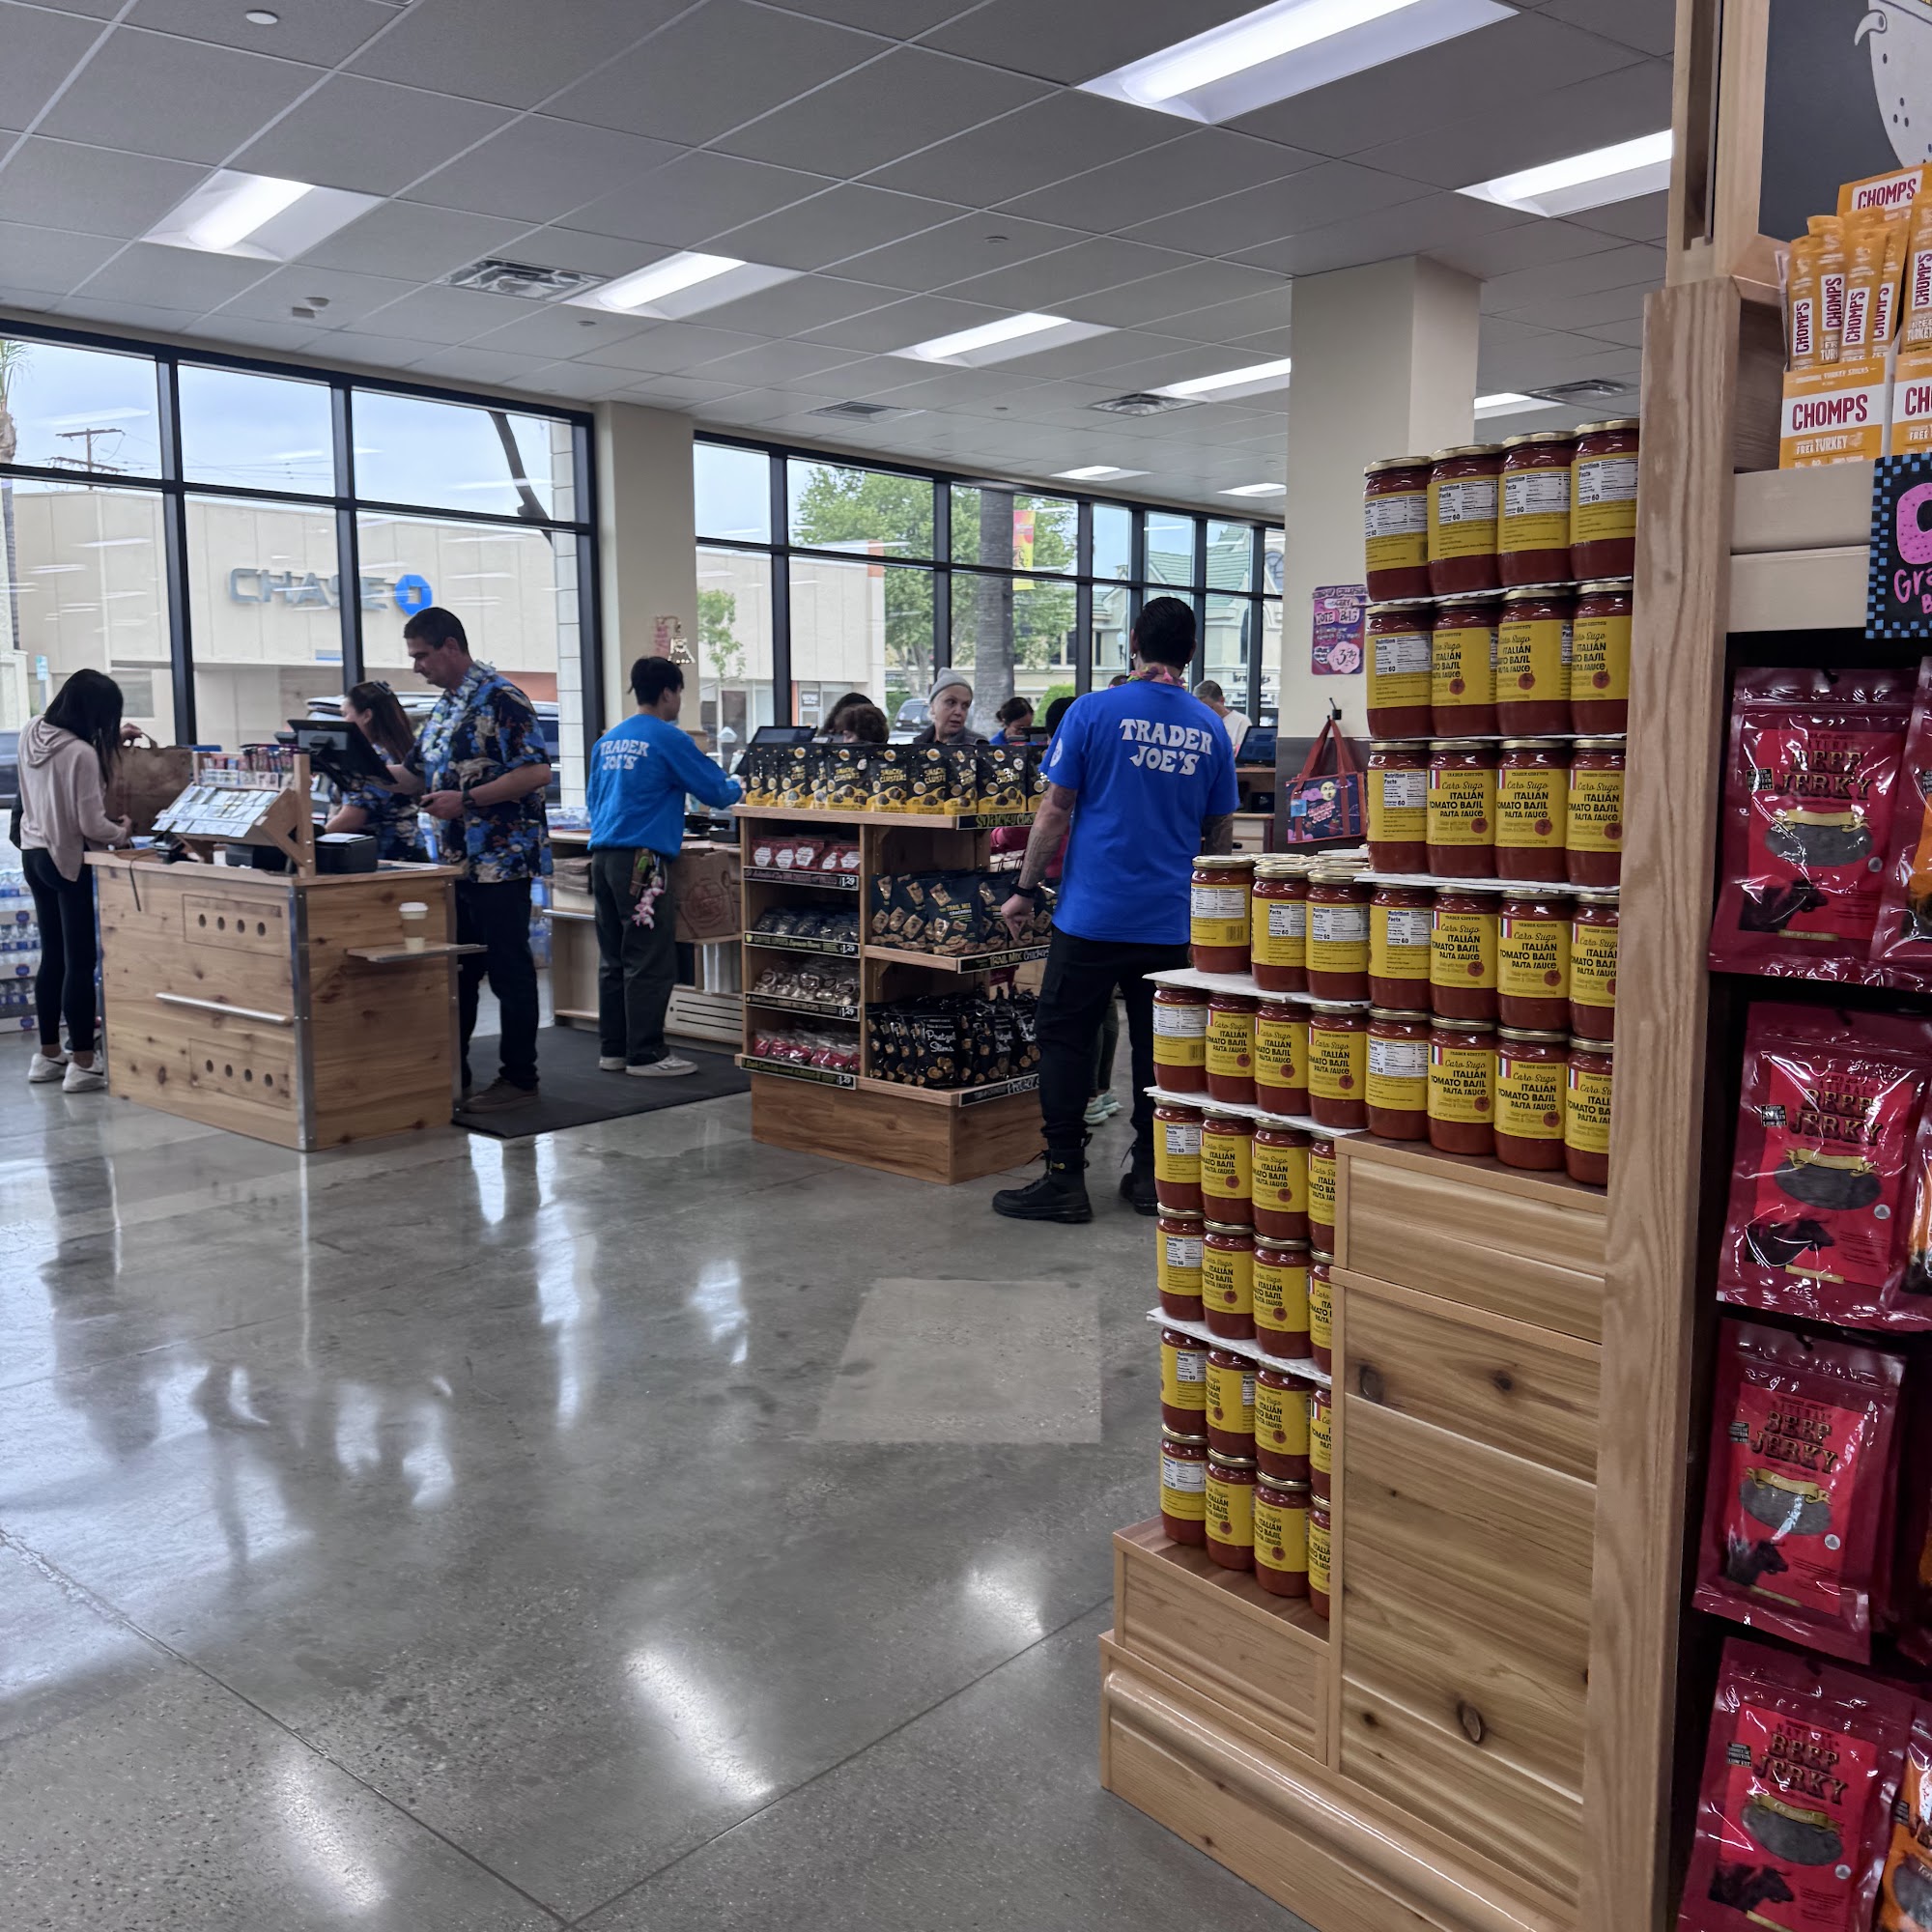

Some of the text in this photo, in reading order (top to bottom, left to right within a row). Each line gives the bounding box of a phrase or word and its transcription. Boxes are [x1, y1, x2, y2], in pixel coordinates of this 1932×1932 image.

[1857, 178, 1917, 211] CHOMPS
[1825, 277, 1843, 328] CHOMPS
[1845, 291, 1865, 343] CHOMPS
[1795, 301, 1810, 355] CHOMPS
[1792, 394, 1868, 431] CHOMPS
[1815, 436, 1848, 452] TURKEY
[1503, 645, 1531, 654] ITALIAN
[1577, 642, 1606, 651] ITALIAN
[1119, 719, 1213, 755] TRADER
[600, 739, 649, 756] TRADER
[1129, 745, 1200, 776] JOE'S
[1776, 774, 1873, 800] JERKY
[1584, 794, 1620, 803] ITALIAN
[1594, 804, 1619, 812] BASIL
[1457, 944, 1480, 952] BASIL
[1521, 943, 1557, 952] ITALIAN
[1533, 952, 1557, 961] BASIL
[1596, 960, 1616, 969] BASI
[925, 1030, 956, 1043] Pretzel
[929, 1041, 954, 1052] Slims
[1264, 1039, 1292, 1048] ITALIAN
[1321, 1050, 1350, 1059] ITALIAN
[1453, 1070, 1487, 1079] ITALIAN
[1463, 1079, 1486, 1088] BASIL
[1521, 1084, 1557, 1093] ITALIAN
[1532, 1094, 1556, 1102] BASIL
[1588, 1095, 1610, 1106] ITALI
[1533, 1102, 1556, 1111] SAUCE
[1789, 1112, 1883, 1146] JERKY
[1262, 1164, 1288, 1173] ITALIAN
[1750, 1431, 1838, 1474] JERKY
[1753, 1754, 1848, 1805] JERKY
